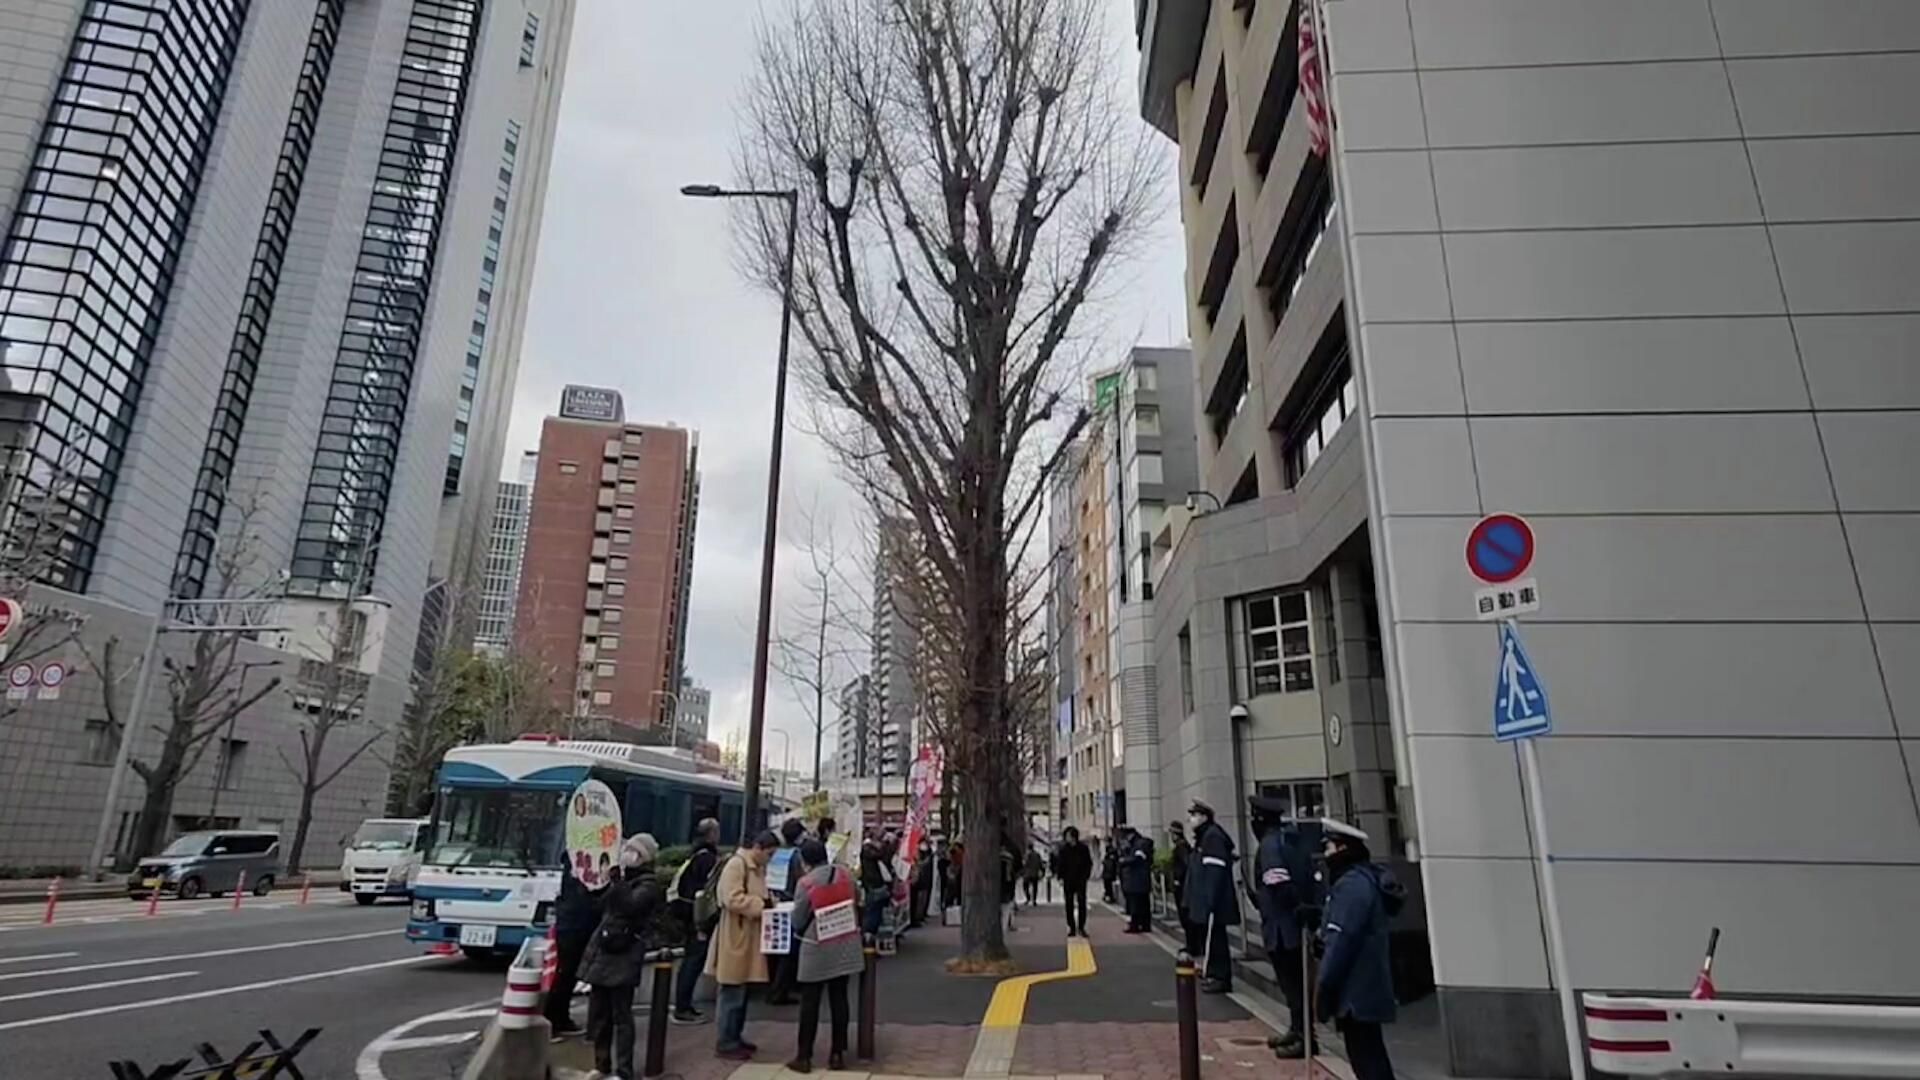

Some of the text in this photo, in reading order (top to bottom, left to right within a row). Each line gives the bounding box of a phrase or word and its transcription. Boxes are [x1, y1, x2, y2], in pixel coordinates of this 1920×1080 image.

[577, 390, 606, 399] PLAZA
[1479, 588, 1537, 613] 自動車
